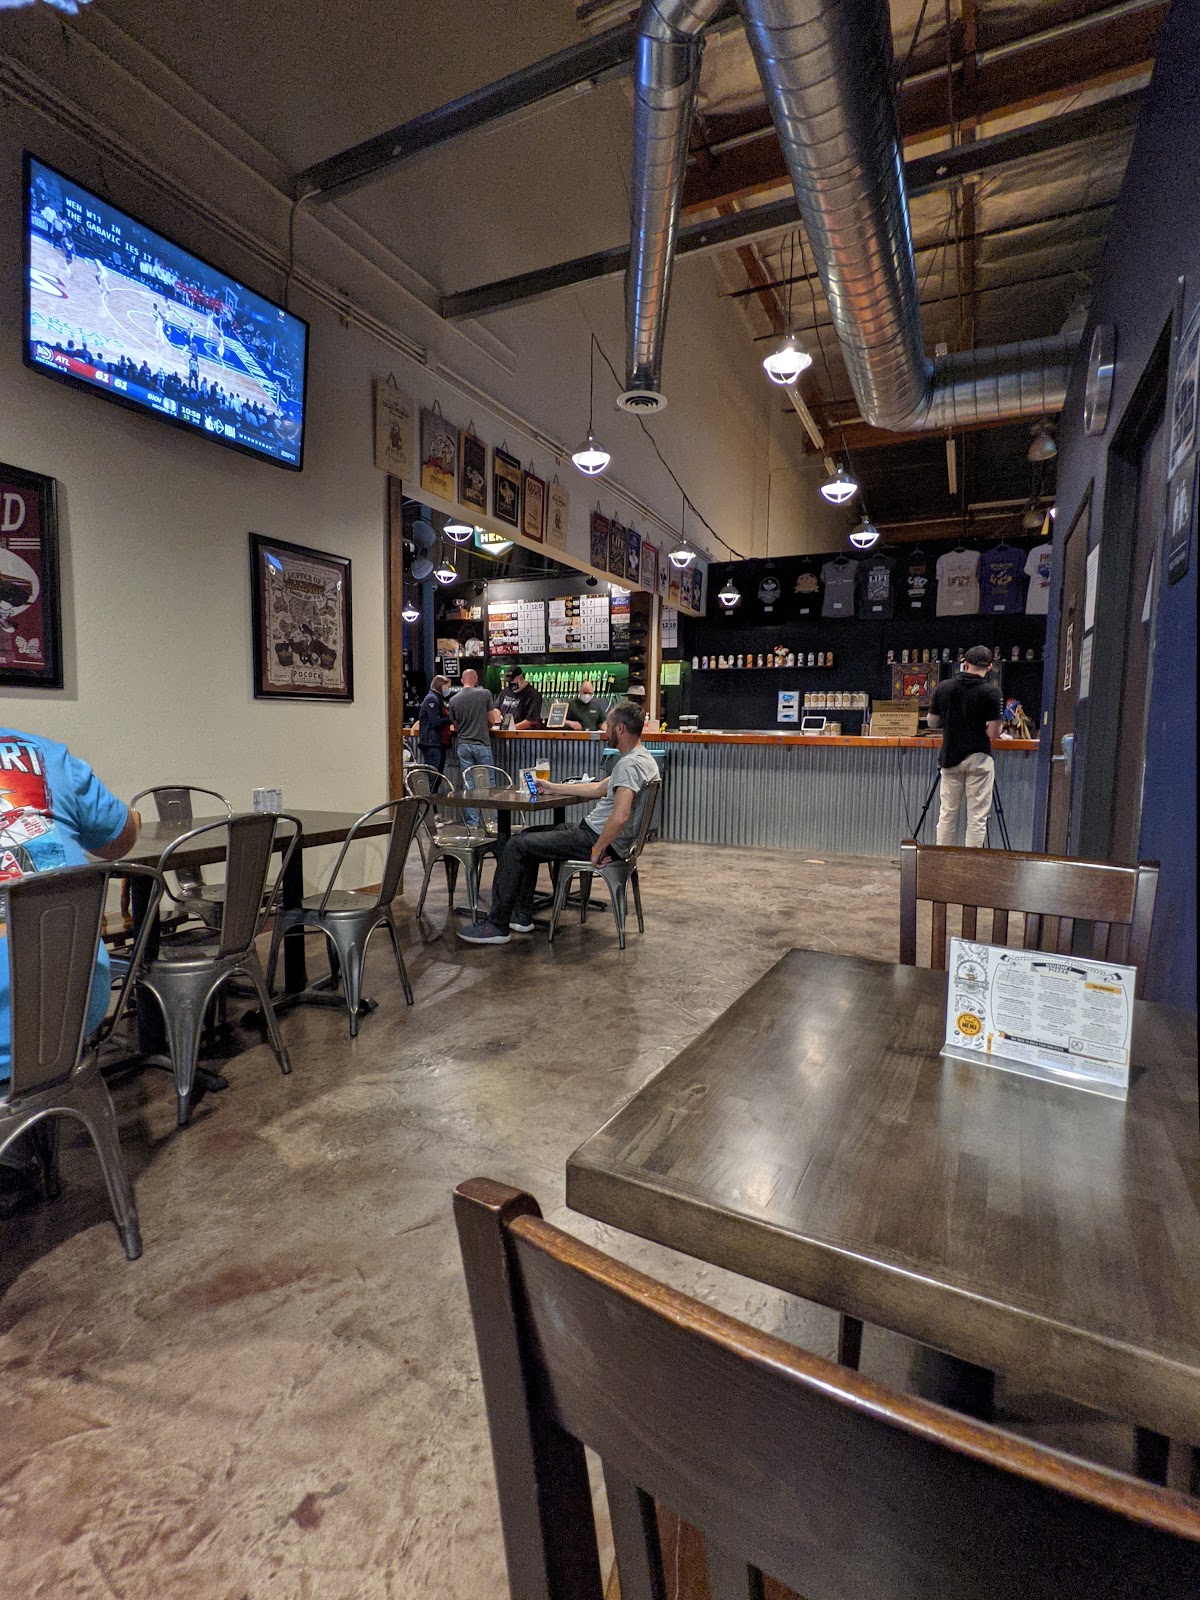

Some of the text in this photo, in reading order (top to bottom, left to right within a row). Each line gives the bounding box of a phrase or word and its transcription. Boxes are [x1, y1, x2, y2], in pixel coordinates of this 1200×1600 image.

[66, 208, 152, 263] THE GABAVIC IES IT
[111, 224, 121, 236] IN
[55, 355, 70, 366] ATL
[94, 370, 109, 383] 61
[113, 378, 127, 390] 61
[181, 406, 201, 419] 10:58
[224, 424, 236, 439] NBA
[1, 492, 26, 532] D
[0, 741, 42, 776] RT
[961, 1022, 977, 1031] MENU
